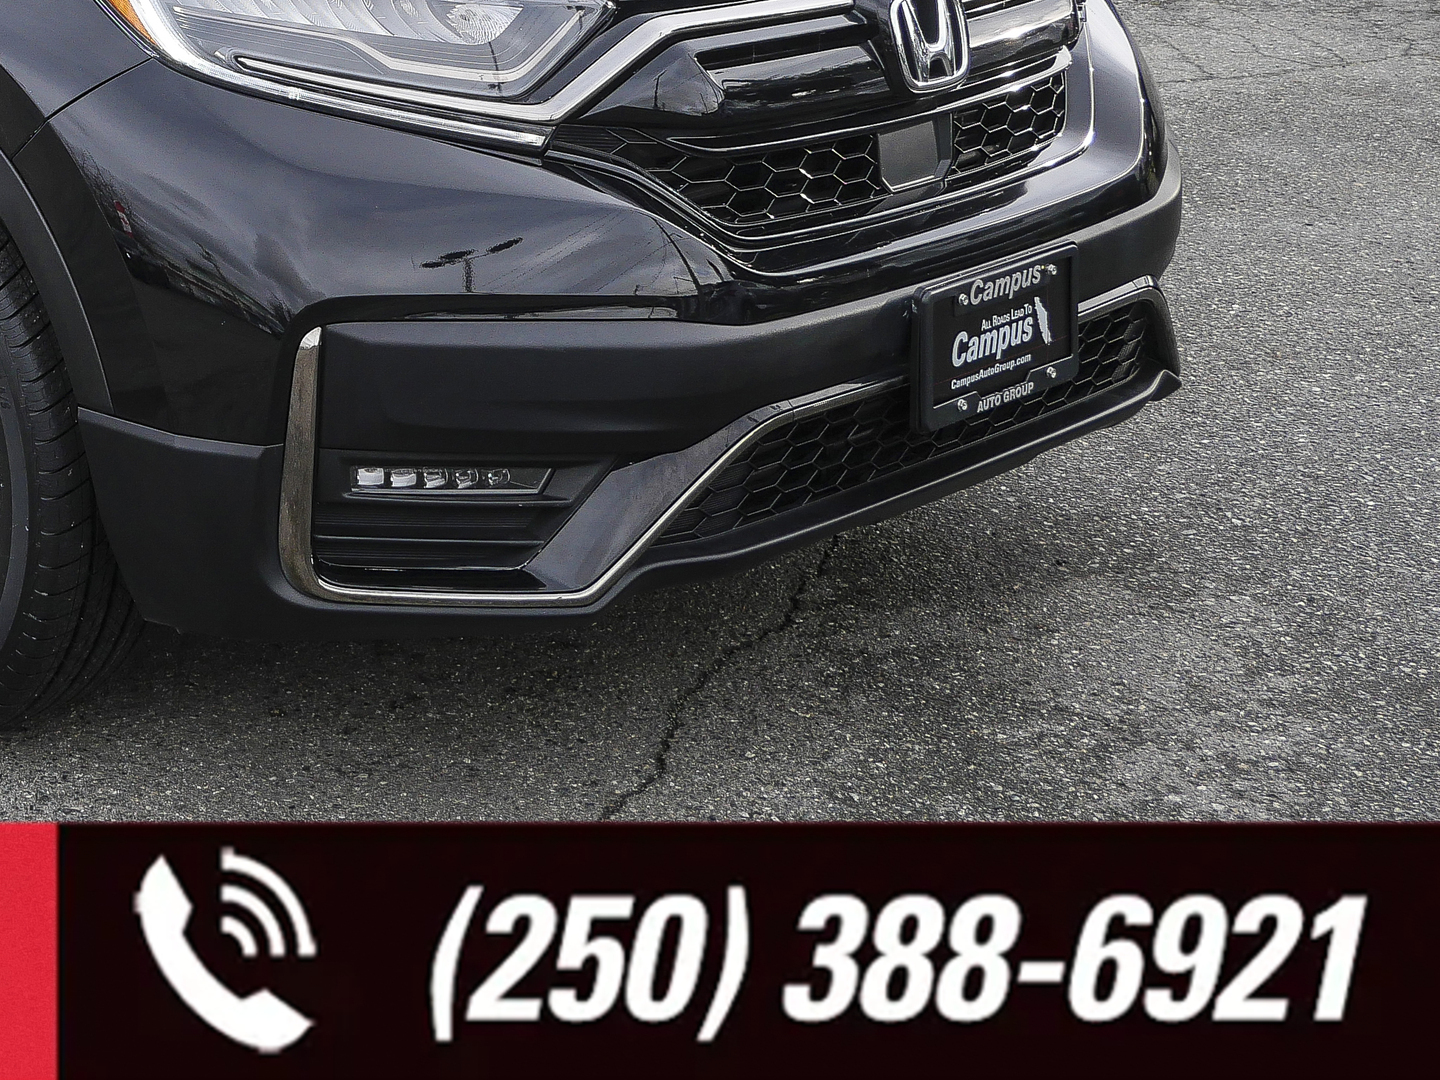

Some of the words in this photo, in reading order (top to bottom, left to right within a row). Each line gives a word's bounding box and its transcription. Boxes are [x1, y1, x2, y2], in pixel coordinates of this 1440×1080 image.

[970, 264, 1042, 305] Campus
[951, 316, 1034, 368] Campus
[950, 353, 1033, 391] CampusAutoGroup.com
[976, 393, 1002, 414] AUTO
[1002, 381, 1035, 402] GROUP
